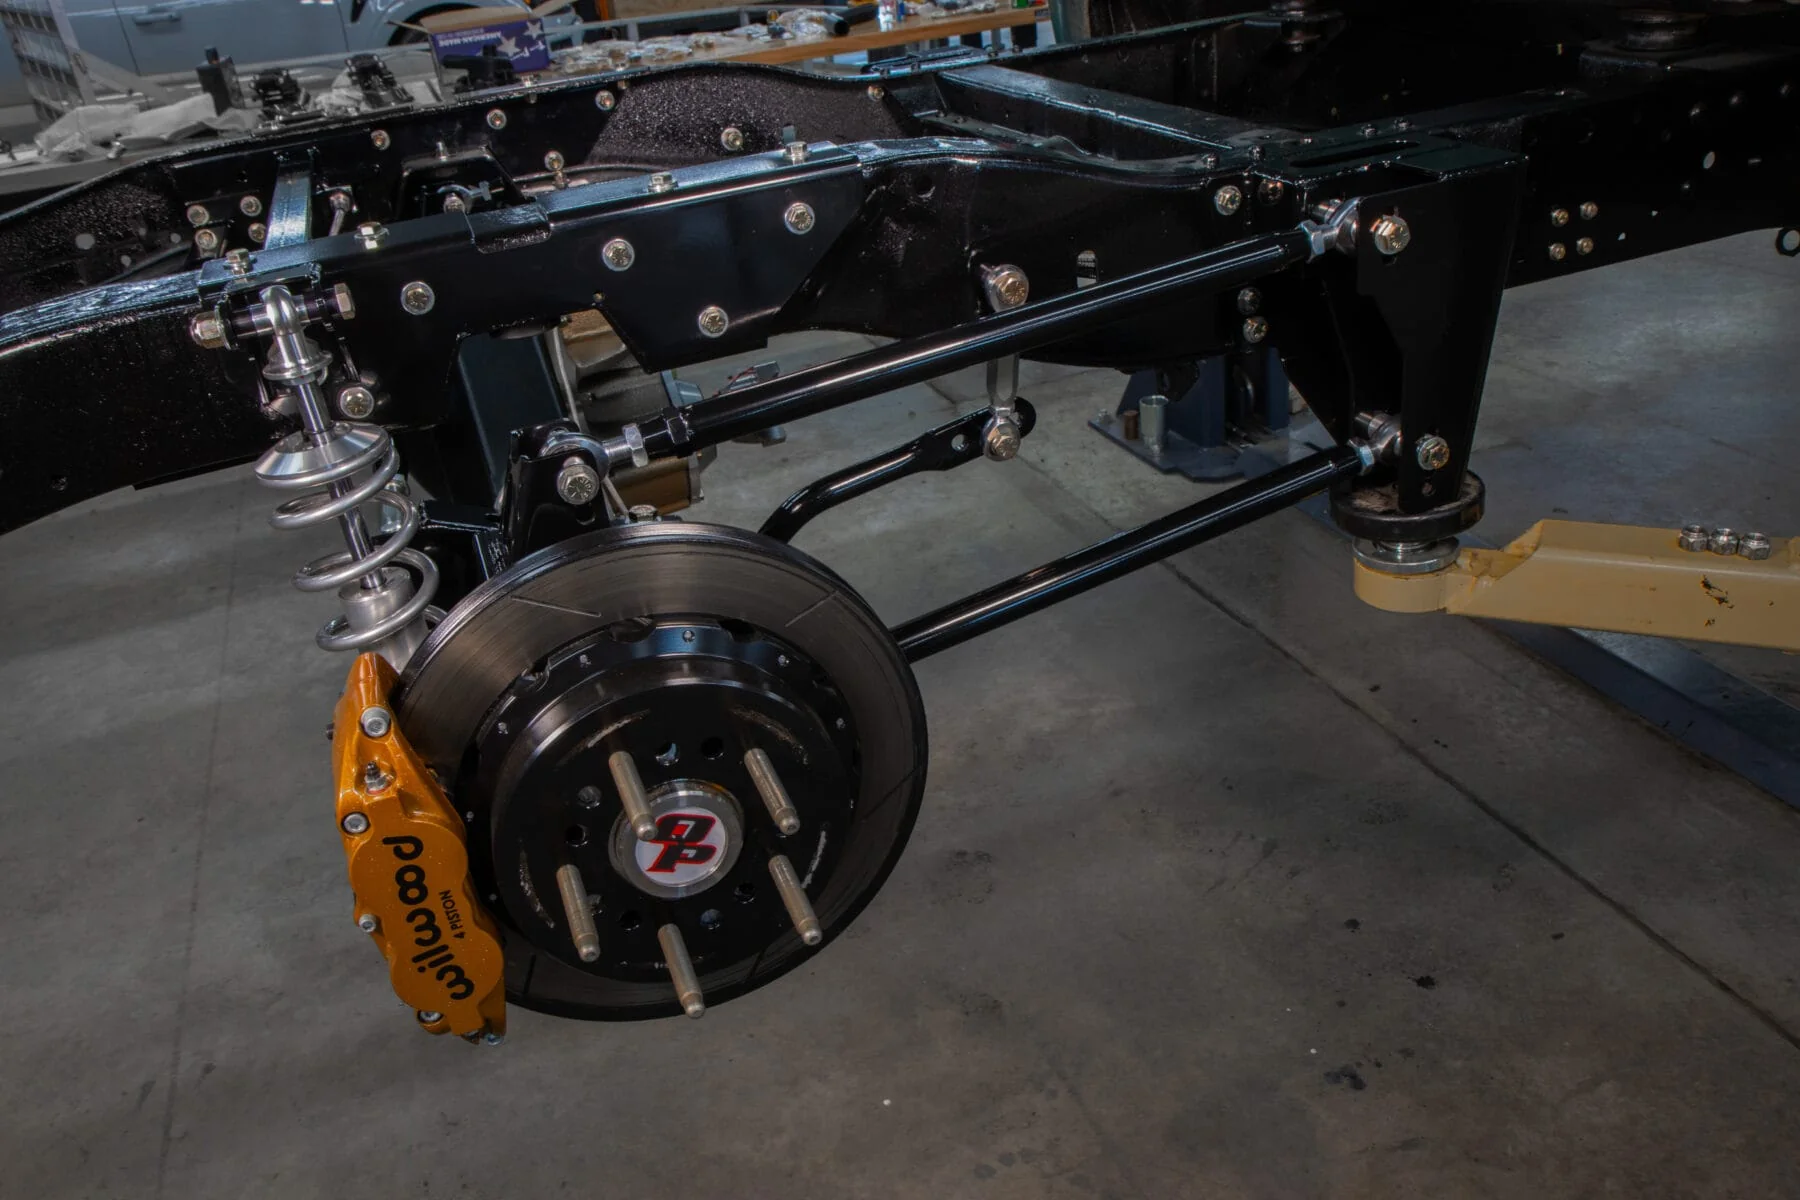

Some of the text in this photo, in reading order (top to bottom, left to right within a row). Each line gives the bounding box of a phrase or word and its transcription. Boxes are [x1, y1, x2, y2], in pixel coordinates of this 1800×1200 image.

[382, 835, 475, 1001] wilwood
[439, 890, 466, 939] 4 PISTON
